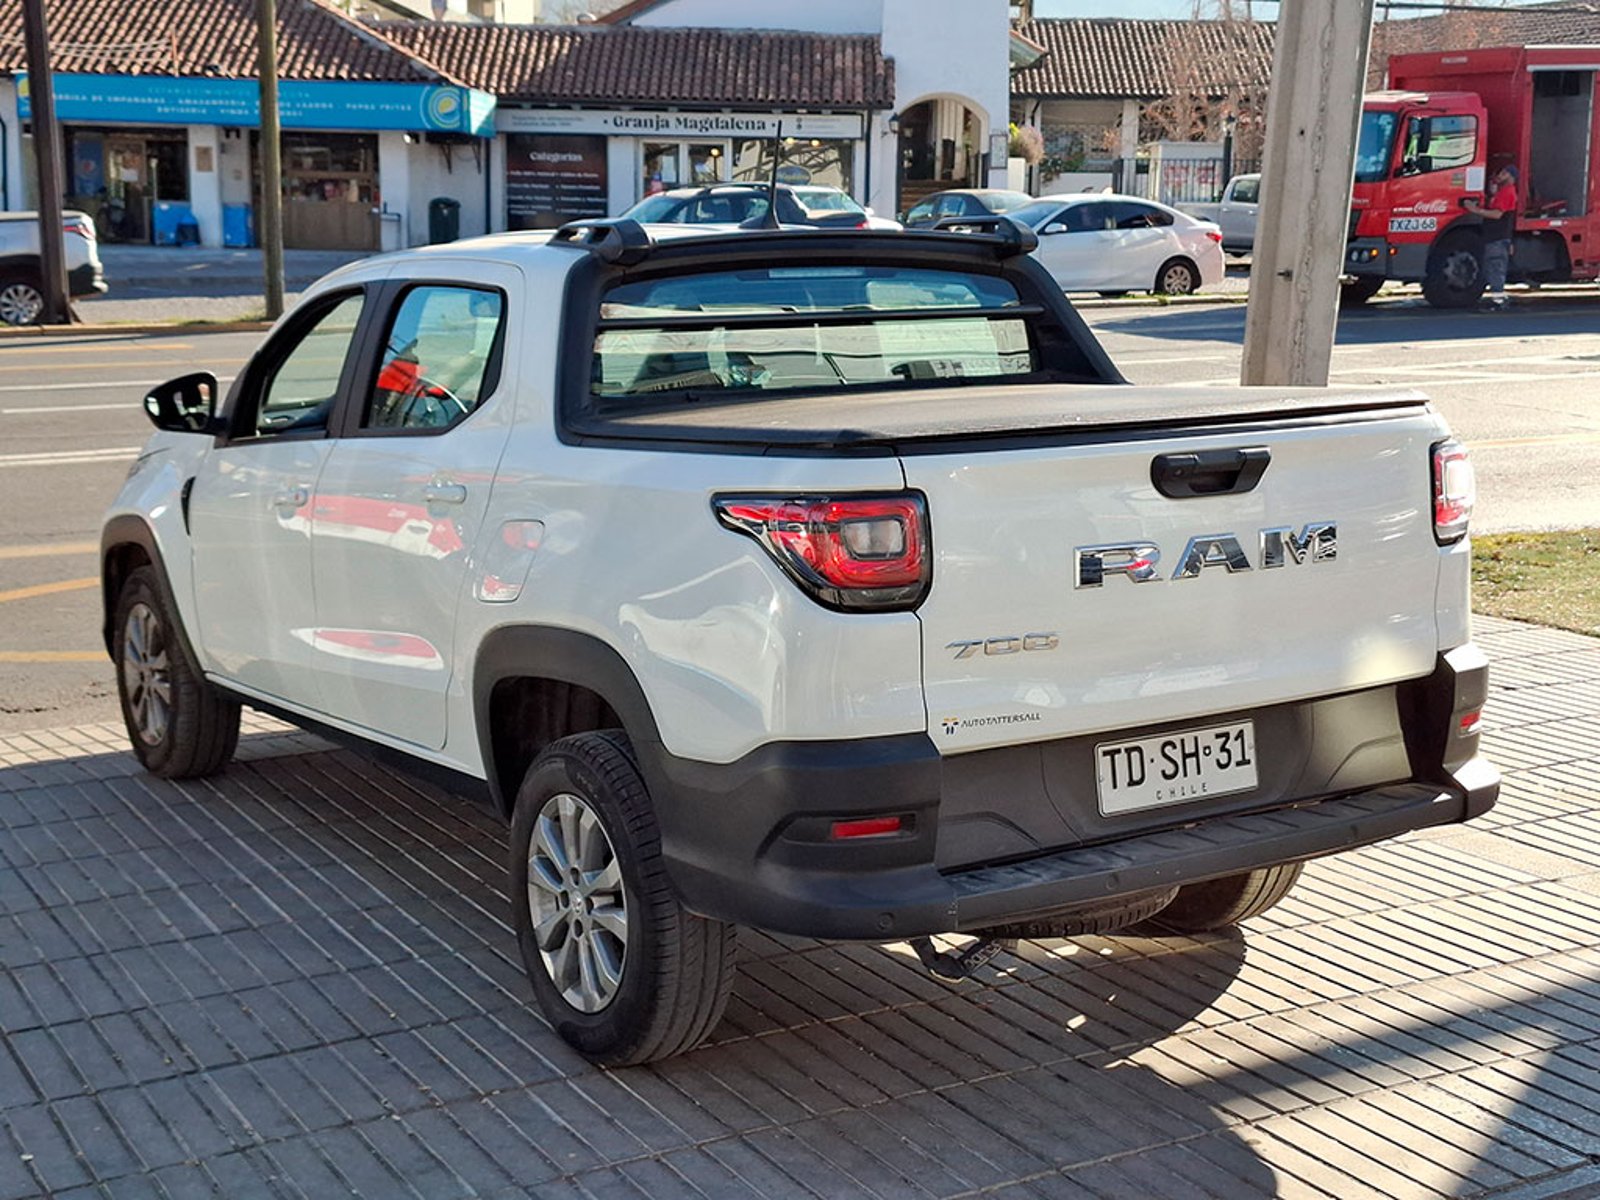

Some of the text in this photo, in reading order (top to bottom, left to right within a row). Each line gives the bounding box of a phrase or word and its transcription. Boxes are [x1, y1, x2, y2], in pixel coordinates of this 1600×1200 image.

[613, 114, 765, 133] Granja Magdalena
[1073, 521, 1338, 590] RAM
[945, 631, 1061, 660] 700
[961, 712, 1041, 728] AUTOTATTERSALL
[1155, 781, 1209, 801] CHILE
